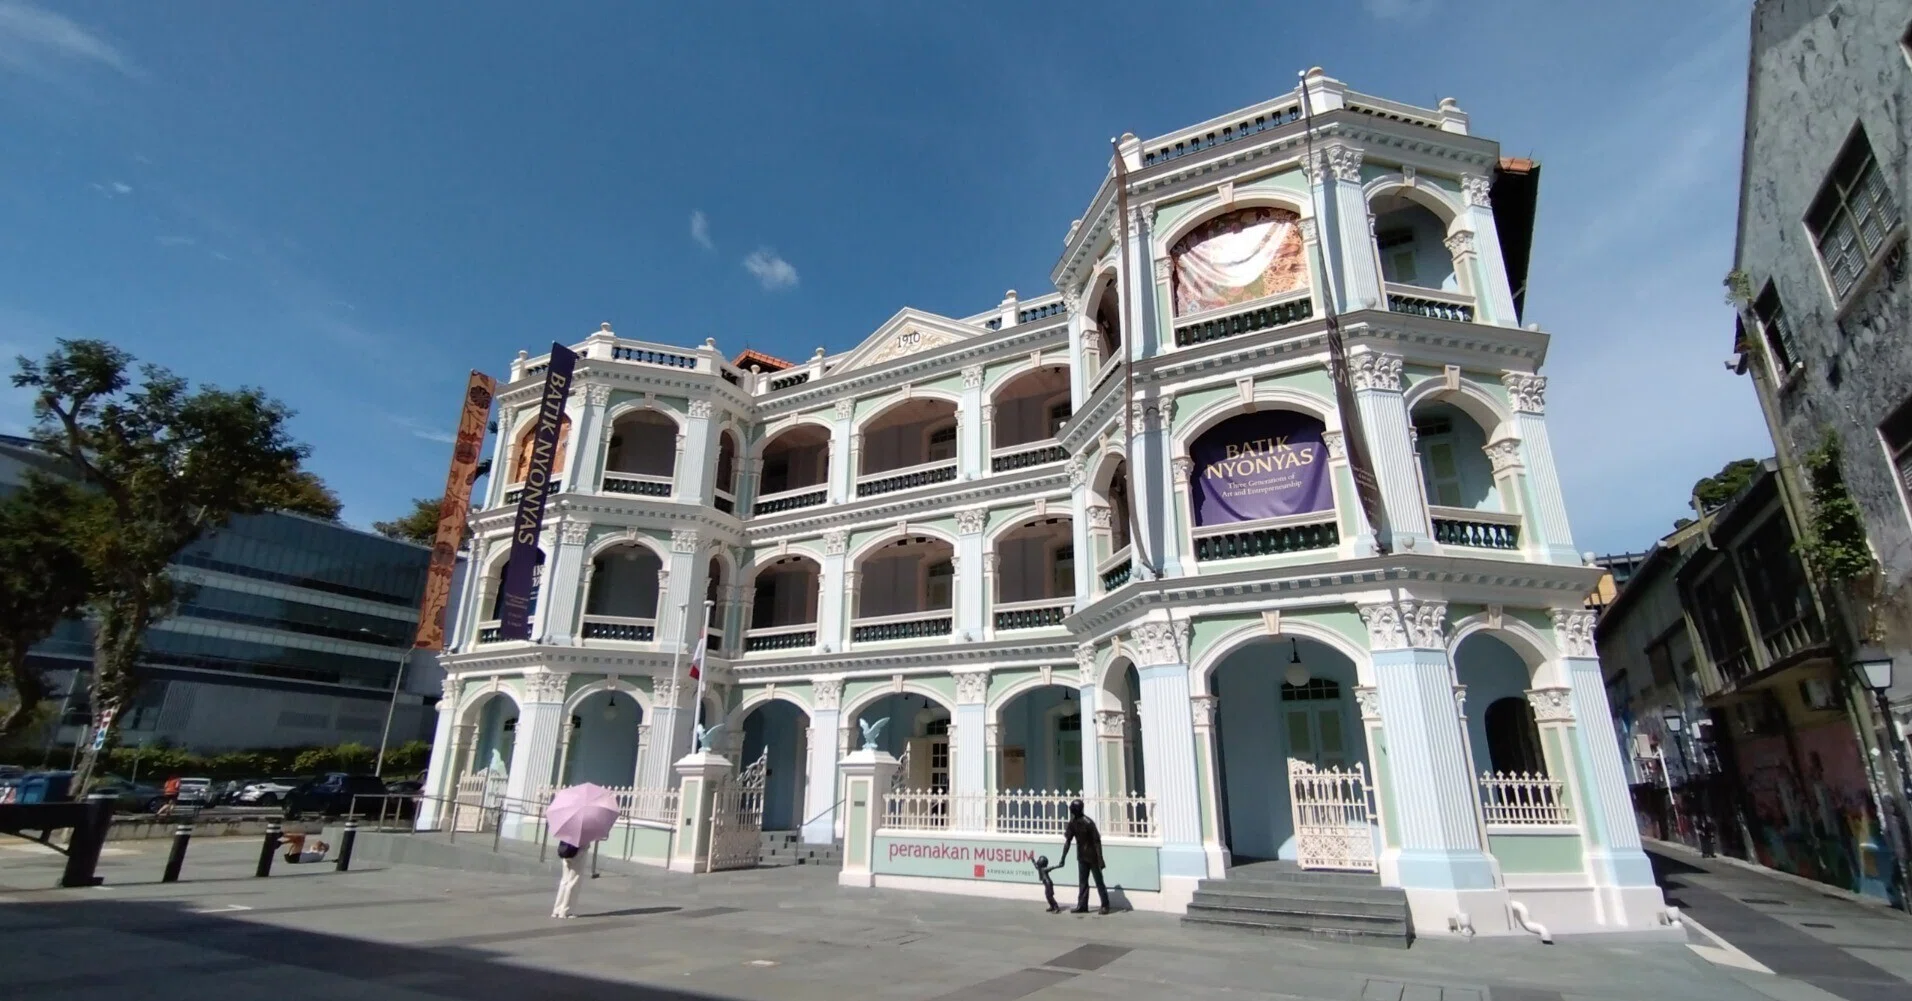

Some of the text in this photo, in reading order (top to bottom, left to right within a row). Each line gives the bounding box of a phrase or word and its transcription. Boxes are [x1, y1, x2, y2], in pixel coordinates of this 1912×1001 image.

[897, 331, 920, 348] 1910
[540, 371, 566, 436] BATIK
[1225, 435, 1292, 460] BATIK
[1206, 448, 1314, 480] NYONYAS
[1234, 487, 1246, 496] and
[1247, 480, 1302, 495] Entrepreneurship
[1248, 475, 1287, 487] Generations
[1287, 471, 1296, 481] of
[518, 438, 553, 546] NYONYAS
[889, 842, 1035, 863] peranakan MUSEUM
